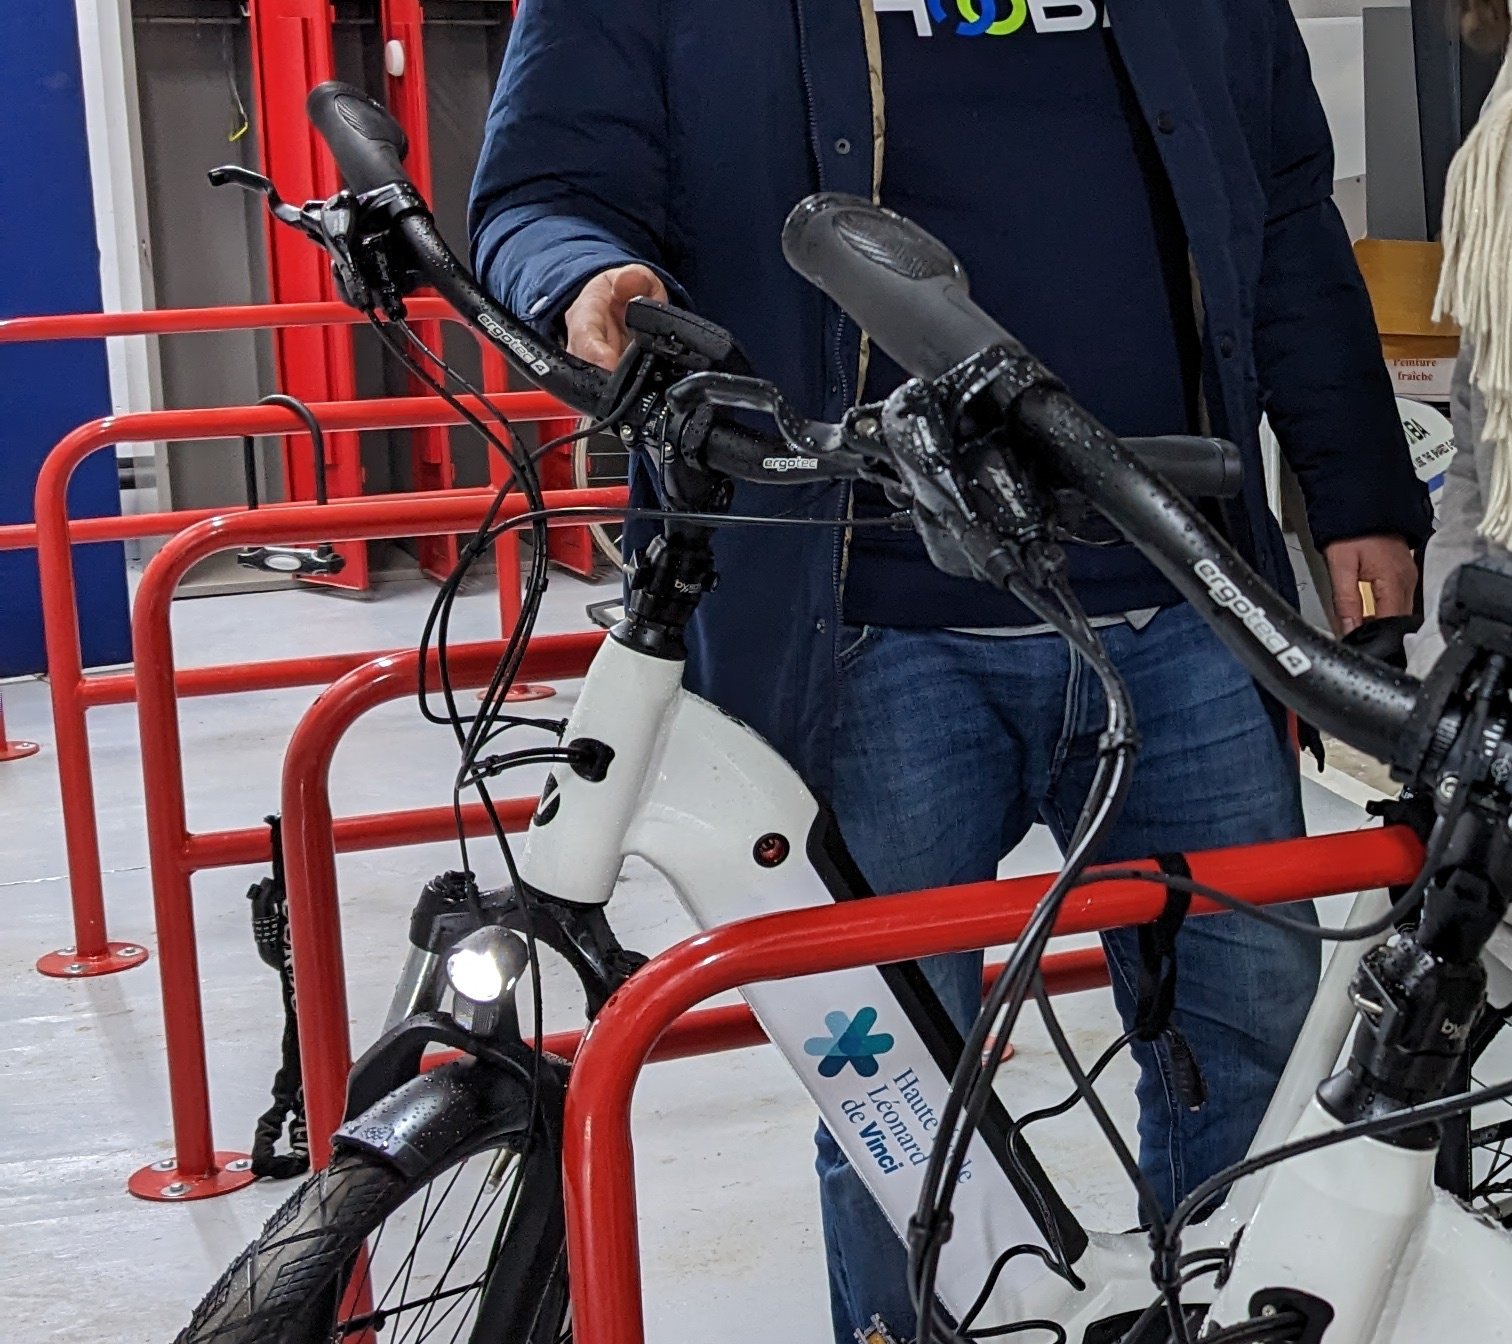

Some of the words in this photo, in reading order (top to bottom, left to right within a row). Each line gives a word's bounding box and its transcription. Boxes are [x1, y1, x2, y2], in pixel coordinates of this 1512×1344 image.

[478, 313, 537, 364] ergotec
[763, 456, 818, 472] ergotec
[1194, 559, 1290, 654] ergotec
[866, 1084, 930, 1167] Léonard
[892, 1067, 939, 1131] Haute
[841, 1099, 866, 1124] de
[859, 1120, 905, 1175] Vinci
